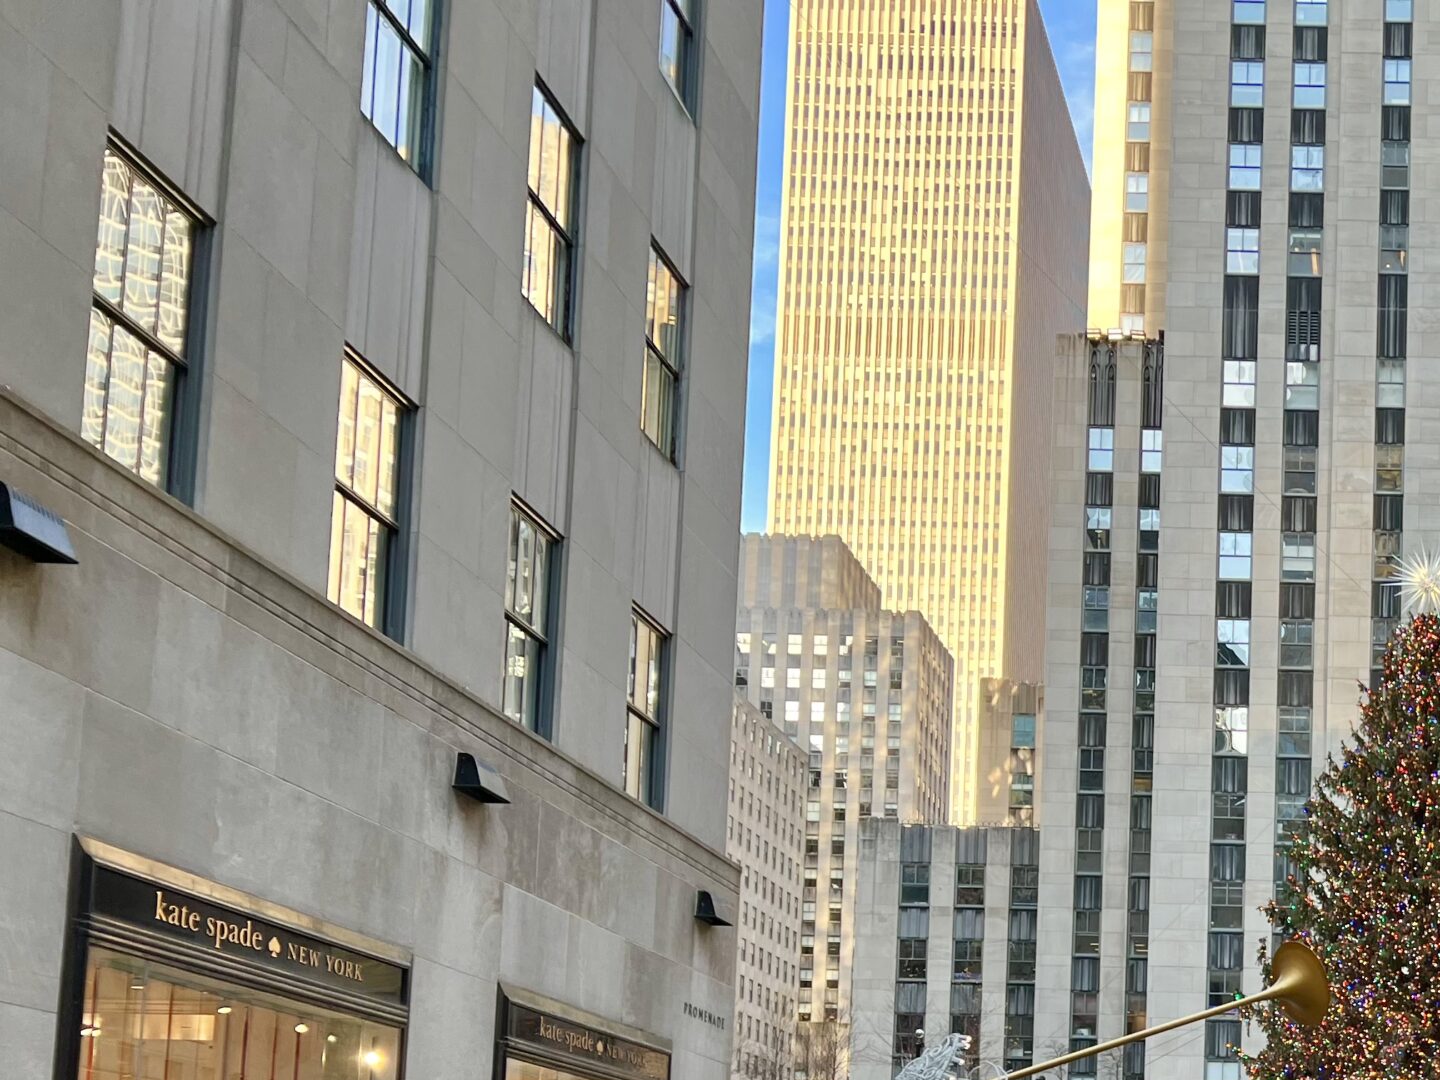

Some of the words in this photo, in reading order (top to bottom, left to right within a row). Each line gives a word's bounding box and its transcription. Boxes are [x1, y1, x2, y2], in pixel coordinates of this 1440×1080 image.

[155, 891, 200, 932] kate
[206, 917, 263, 950] spade
[287, 942, 320, 968] NEW
[325, 954, 363, 982] YORK
[539, 1016, 562, 1042] kate
[565, 1031, 594, 1052] spade
[606, 1043, 625, 1059] NEW
[683, 1002, 725, 1030] PROMENADE
